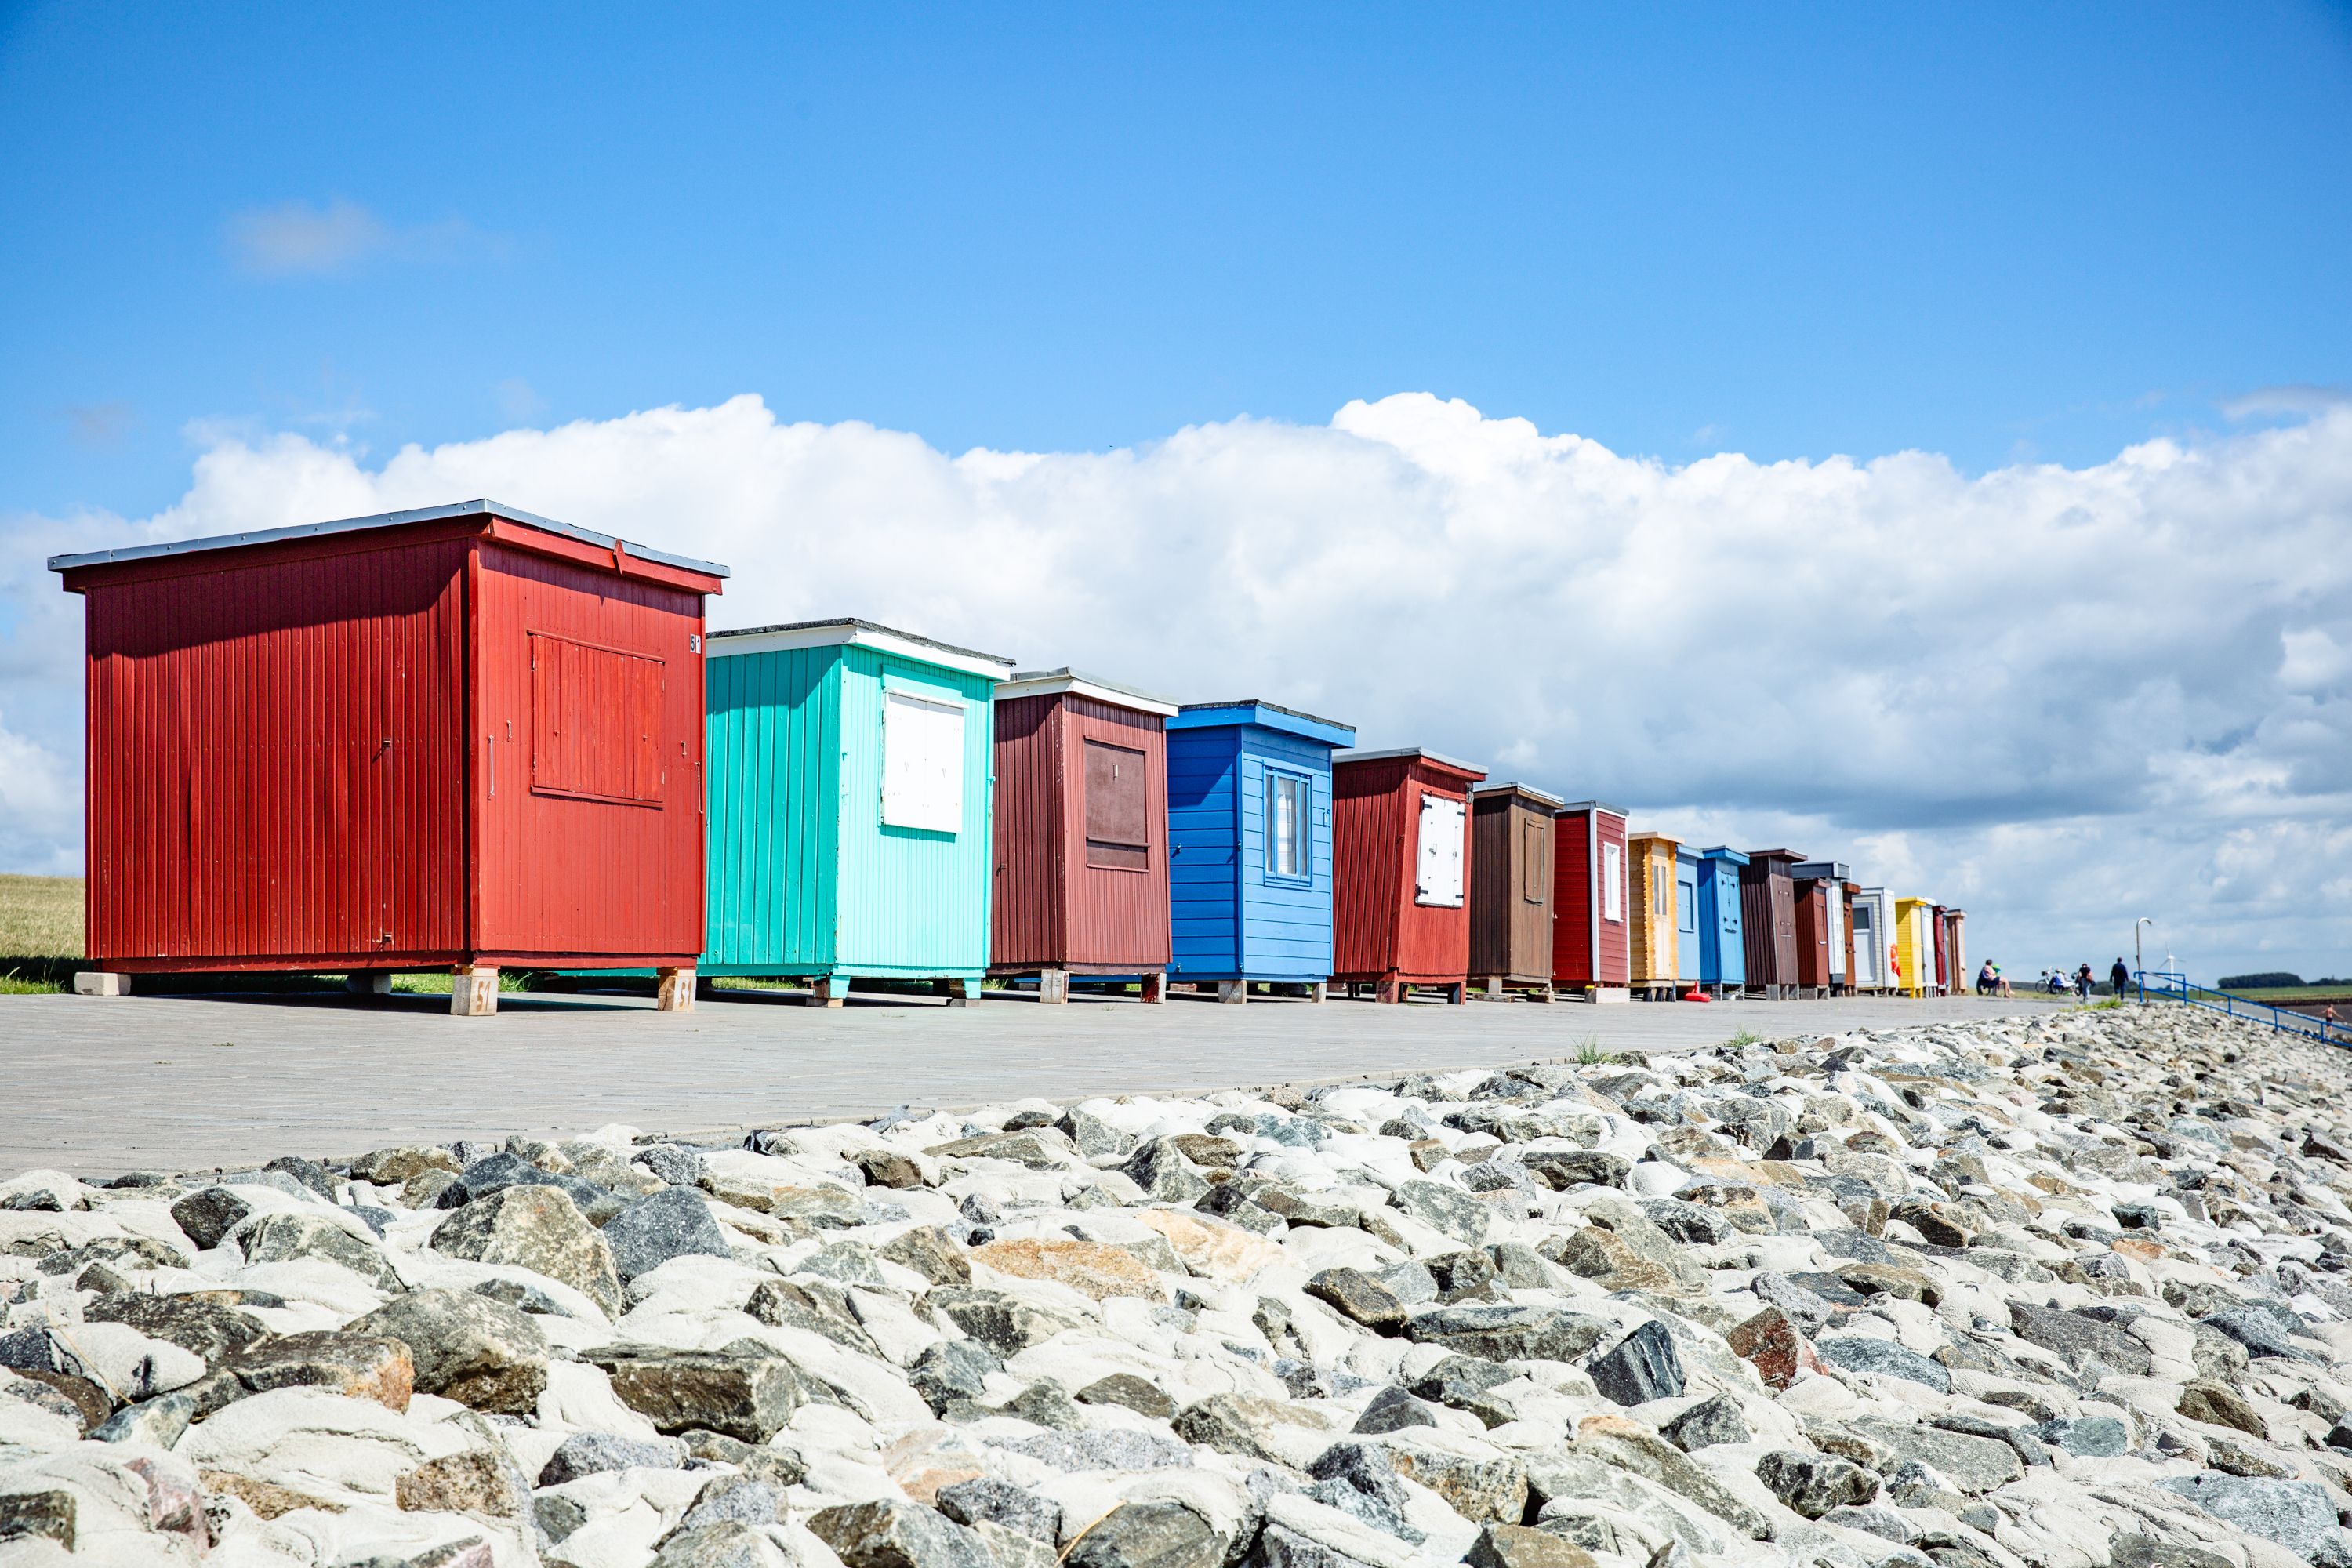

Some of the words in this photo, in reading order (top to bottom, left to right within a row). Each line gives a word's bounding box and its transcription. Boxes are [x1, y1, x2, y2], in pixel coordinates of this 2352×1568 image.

[691, 635, 700, 652] 51
[476, 980, 491, 1013] 51
[679, 980, 691, 1008] 51
